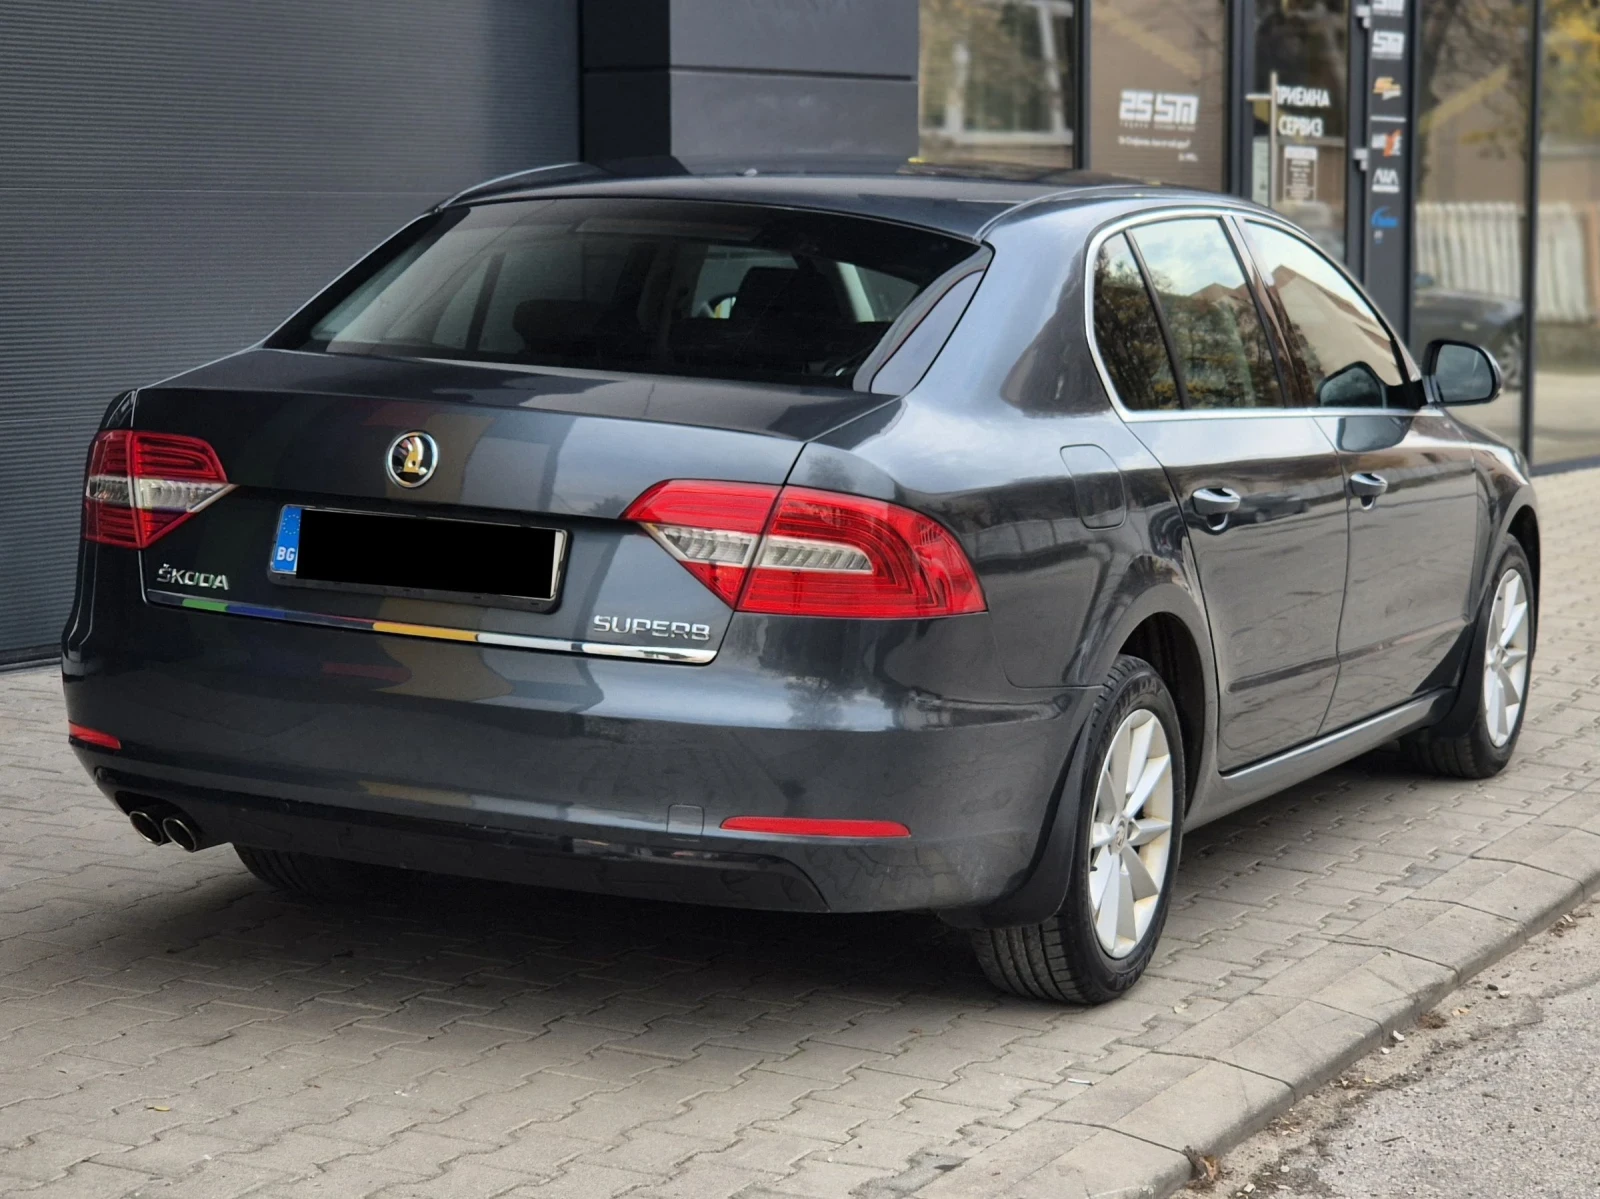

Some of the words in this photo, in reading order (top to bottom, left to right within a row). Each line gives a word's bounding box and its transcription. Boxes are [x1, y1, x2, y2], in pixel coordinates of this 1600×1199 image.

[1278, 115, 1323, 137] СЕРВИЗ
[277, 547, 296, 561] BG
[157, 563, 230, 591] ŠKODA
[593, 614, 711, 641] SUPERB
